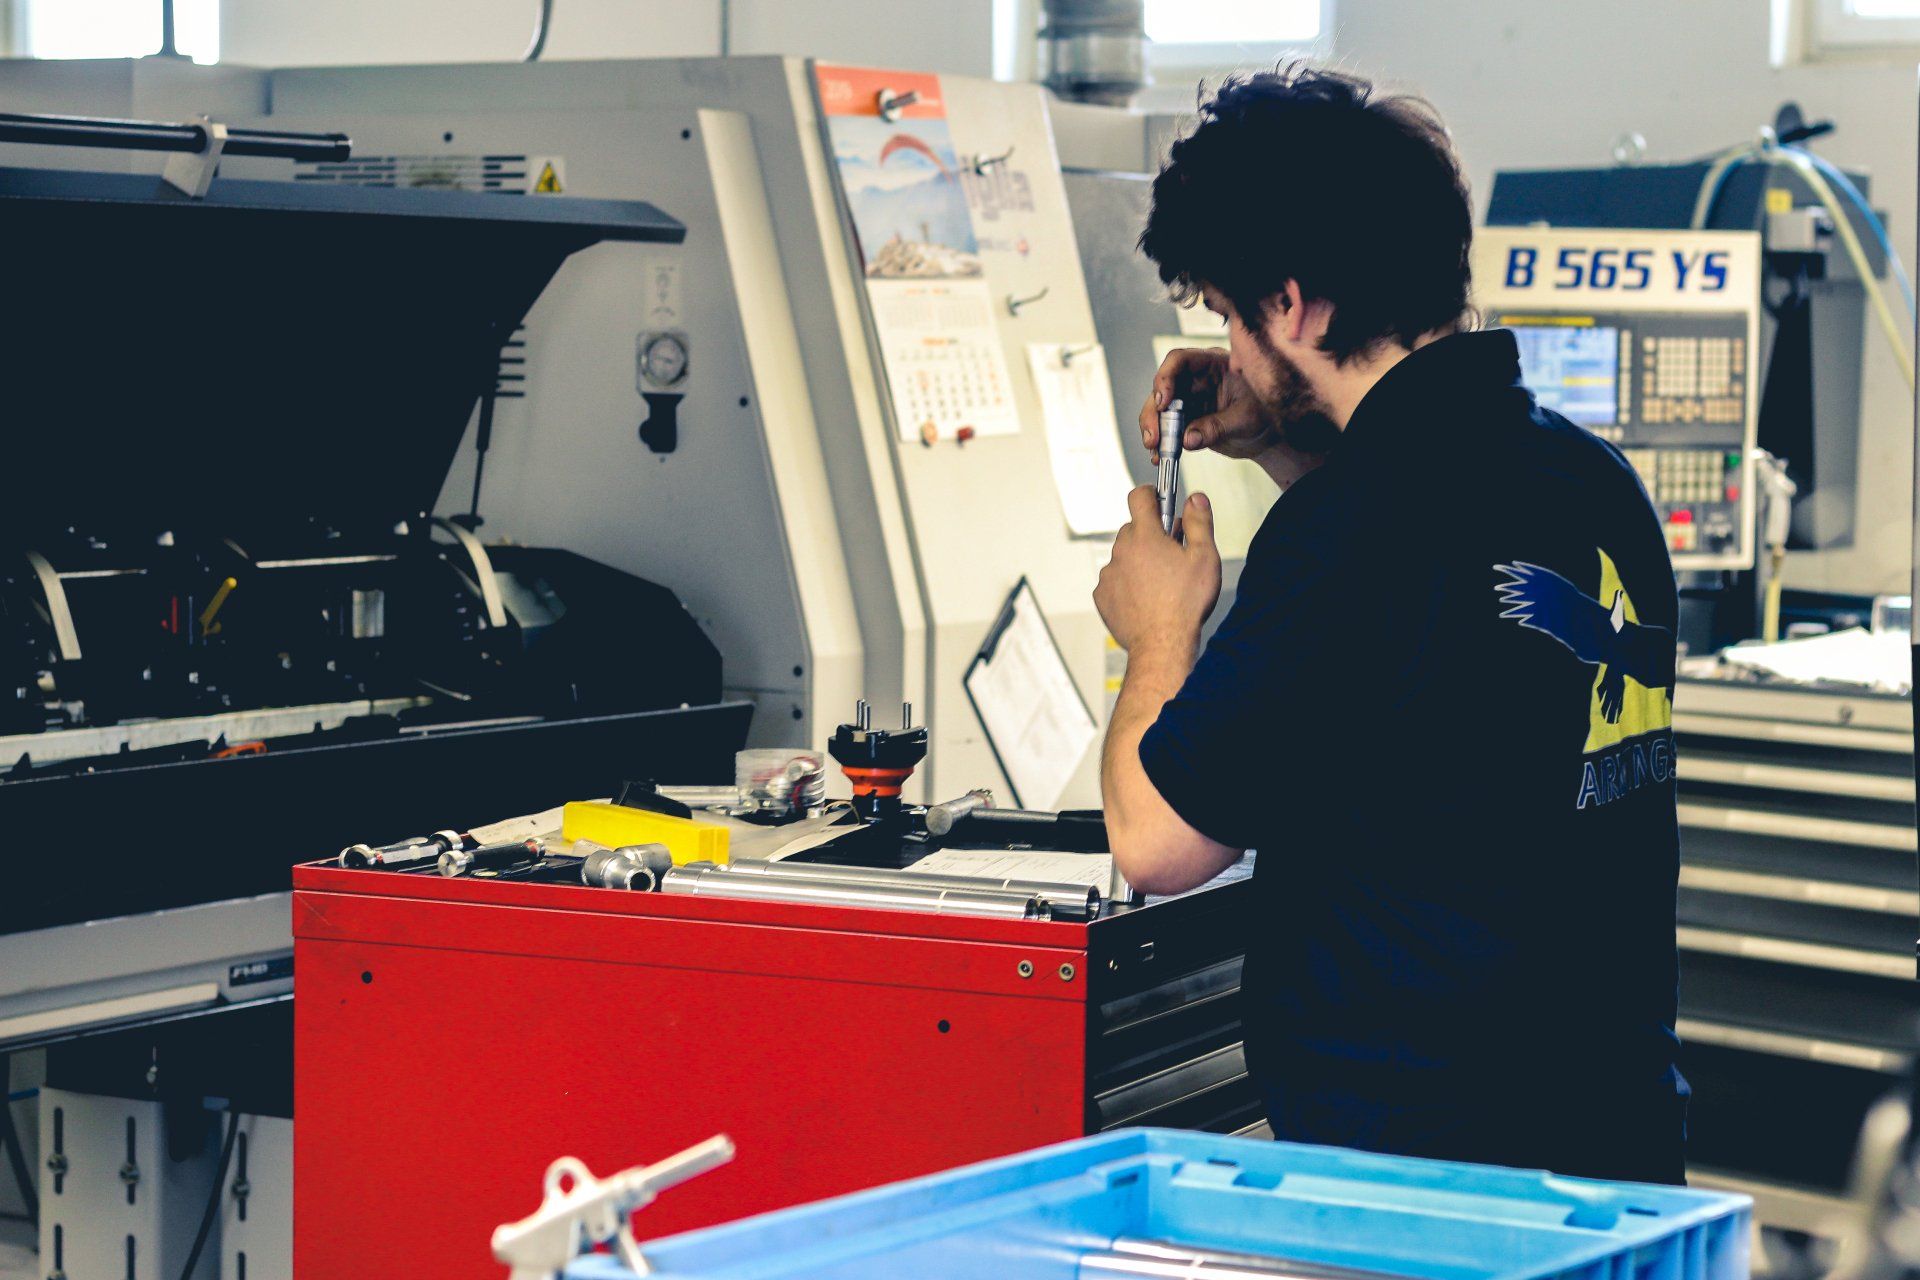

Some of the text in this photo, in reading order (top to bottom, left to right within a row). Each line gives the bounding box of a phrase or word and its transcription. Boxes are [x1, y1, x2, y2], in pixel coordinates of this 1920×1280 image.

[1504, 247, 1730, 292] B 565 YS
